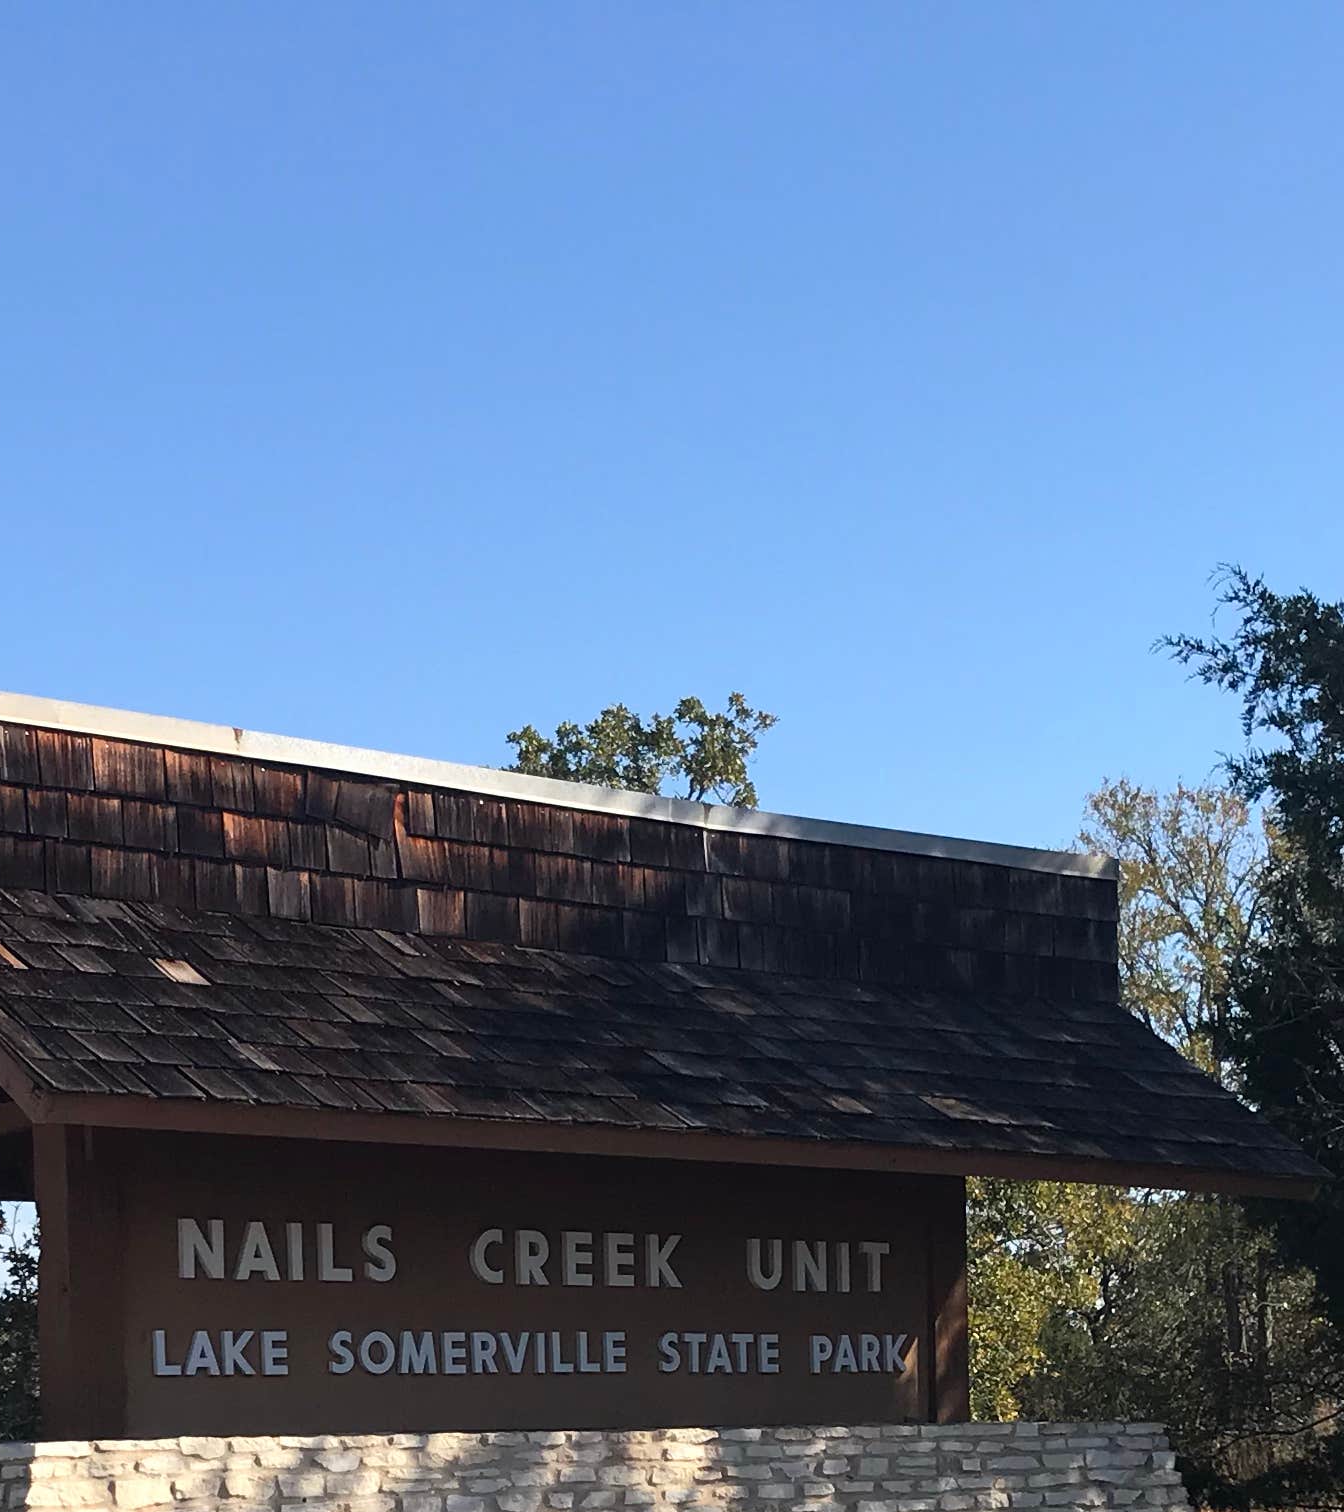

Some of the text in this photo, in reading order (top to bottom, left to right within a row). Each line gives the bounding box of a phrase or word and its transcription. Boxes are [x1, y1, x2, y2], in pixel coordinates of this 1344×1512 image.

[177, 1218, 890, 1293] NAILS CREEK UNIT
[152, 1330, 908, 1377] LAKE SOMERVILLE STATE PARK
